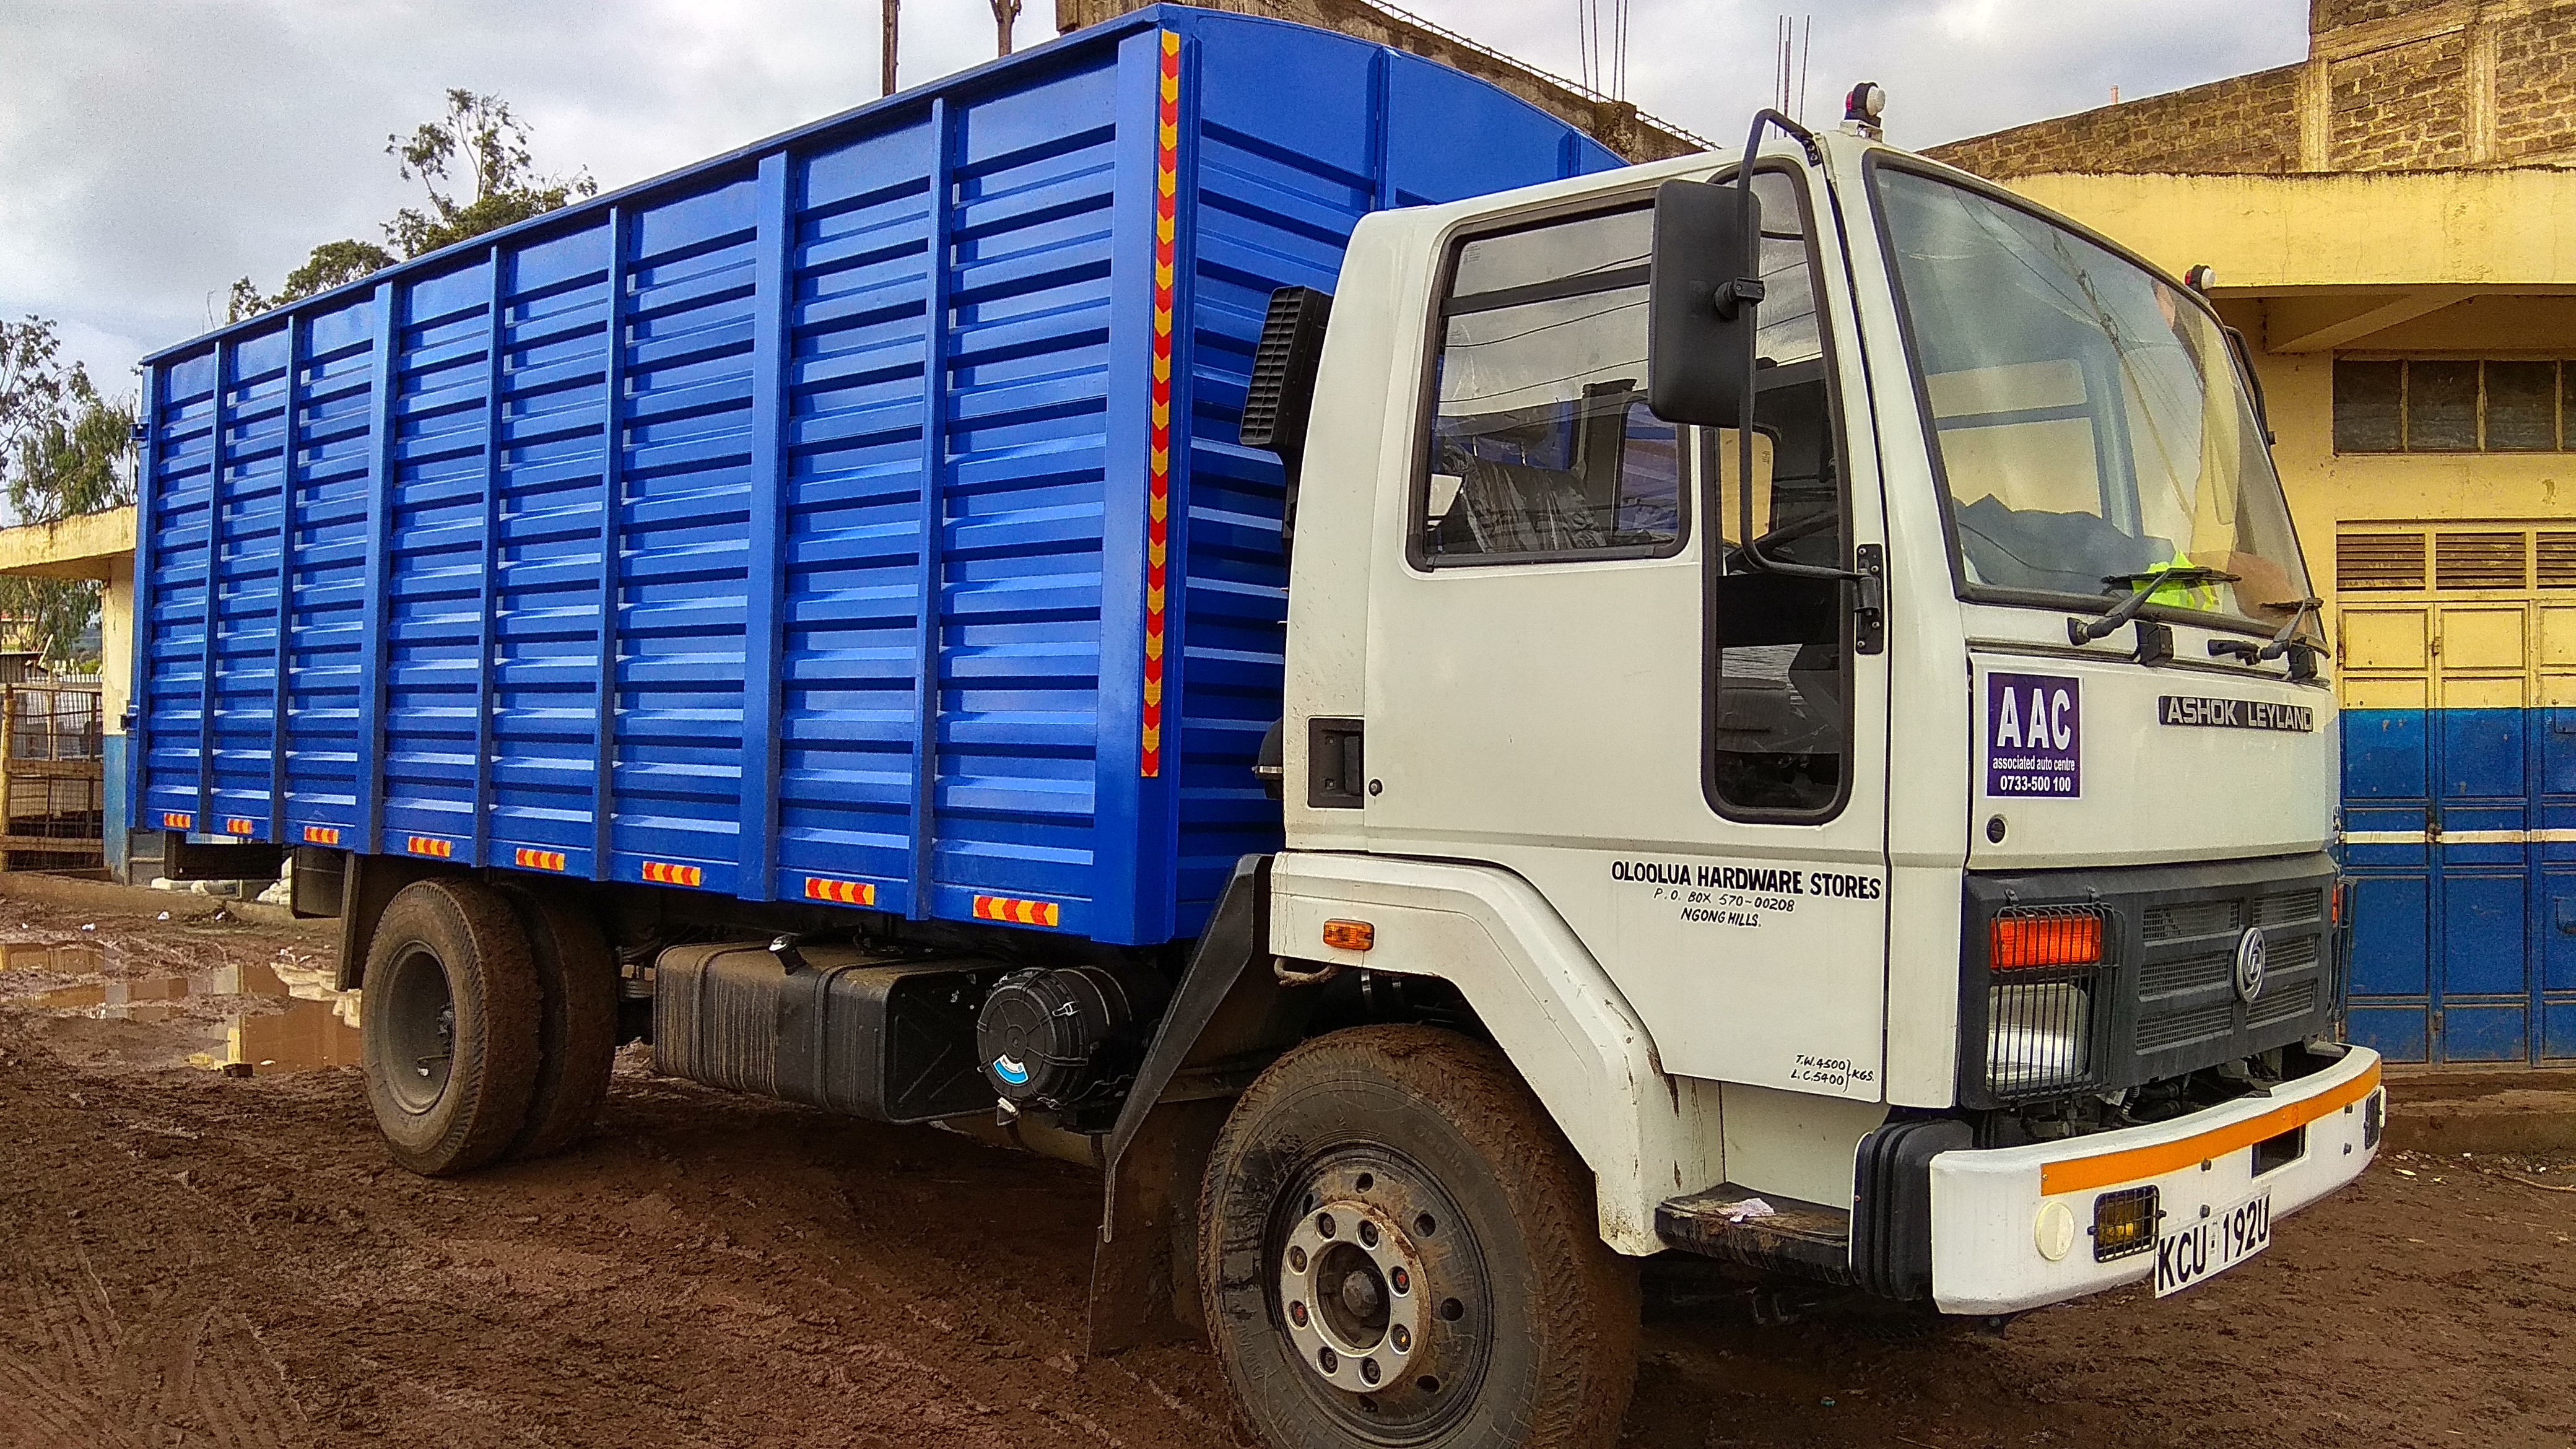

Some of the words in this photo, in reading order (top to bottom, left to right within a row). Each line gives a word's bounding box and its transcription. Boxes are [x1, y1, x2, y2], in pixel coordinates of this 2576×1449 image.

[2167, 697, 2238, 726] ASHOK
[2247, 702, 2313, 731] LEYLAND
[1993, 755, 2035, 770] associated
[2037, 756, 2053, 771] auto
[2053, 757, 2075, 772] centre
[2000, 775, 2050, 791] 0733-500
[2053, 776, 2071, 792] 100
[1612, 861, 1692, 886] OLOOLUA
[1697, 866, 1803, 894] HARDWARE
[1810, 872, 1881, 900] STORES
[1687, 891, 1712, 903] BOX
[1680, 907, 1726, 923] NGONG
[1727, 912, 1762, 928] HILLS.
[2159, 1224, 2207, 1292] KCU
[2223, 1194, 2269, 1263] 192U
